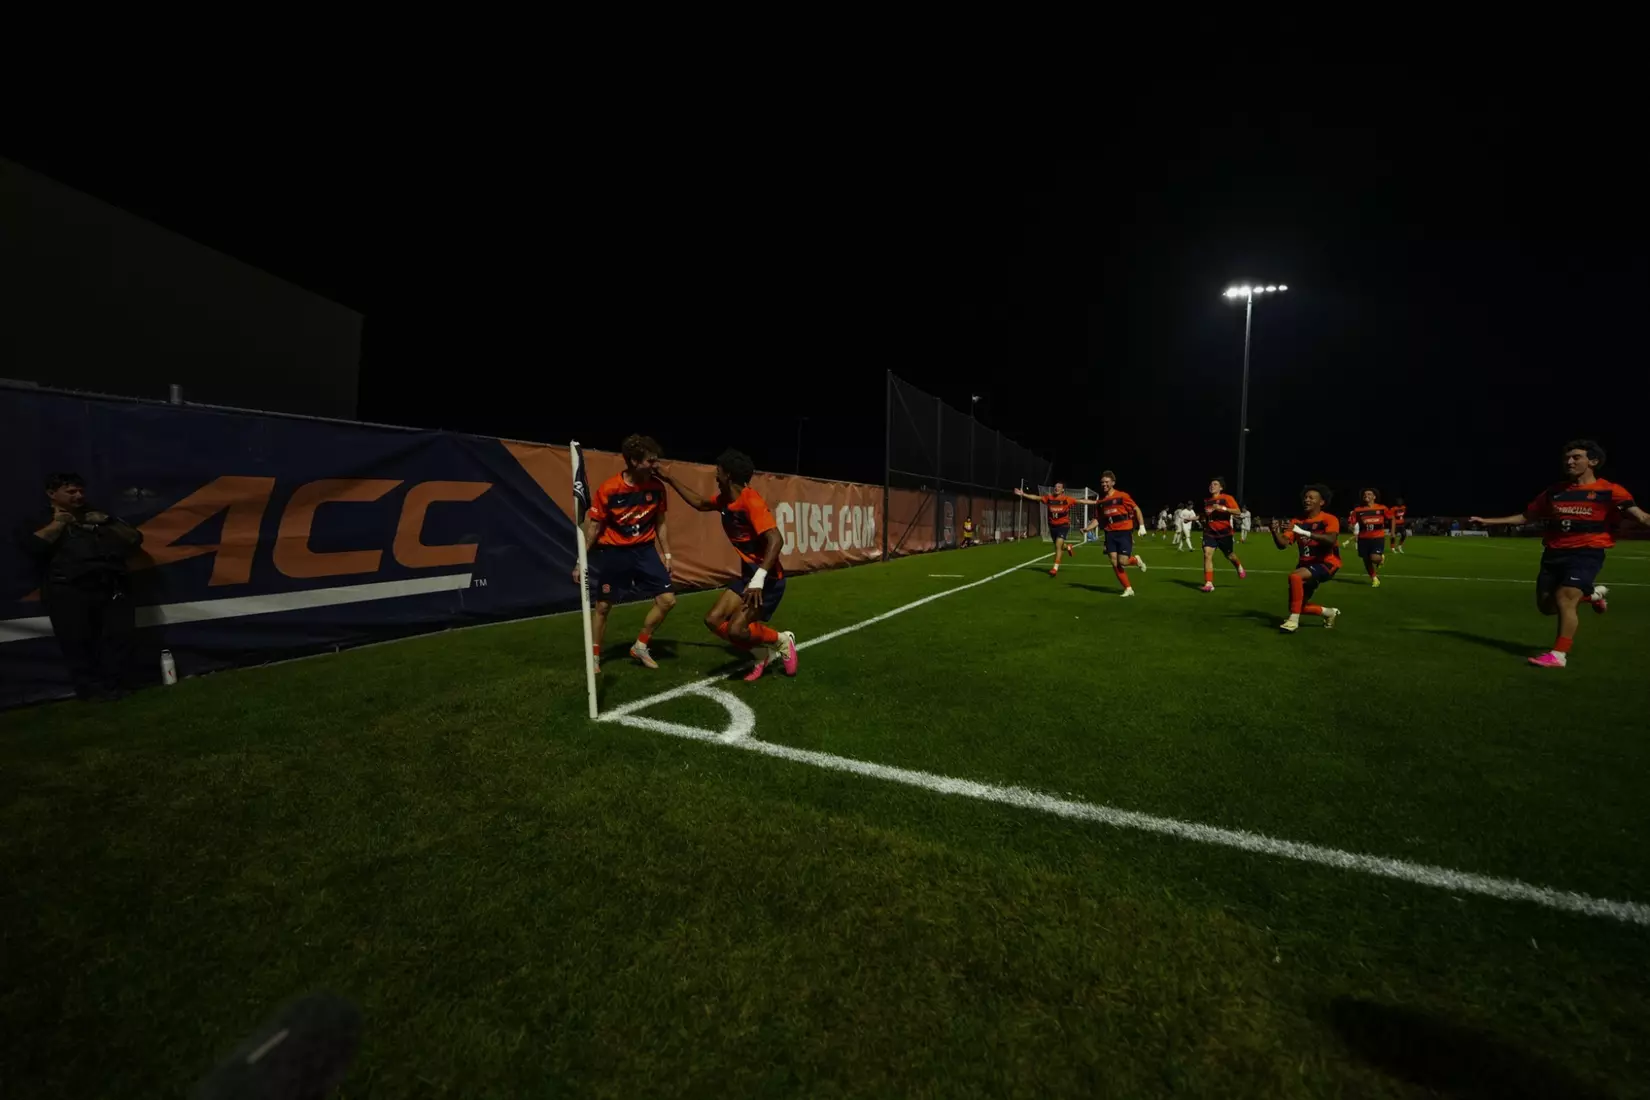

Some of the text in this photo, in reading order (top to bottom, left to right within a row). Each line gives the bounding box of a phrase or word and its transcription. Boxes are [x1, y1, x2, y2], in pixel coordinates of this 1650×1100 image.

[19, 475, 494, 602] ACC
[776, 502, 876, 556] CUSE.COM
[473, 578, 488, 587] TM
